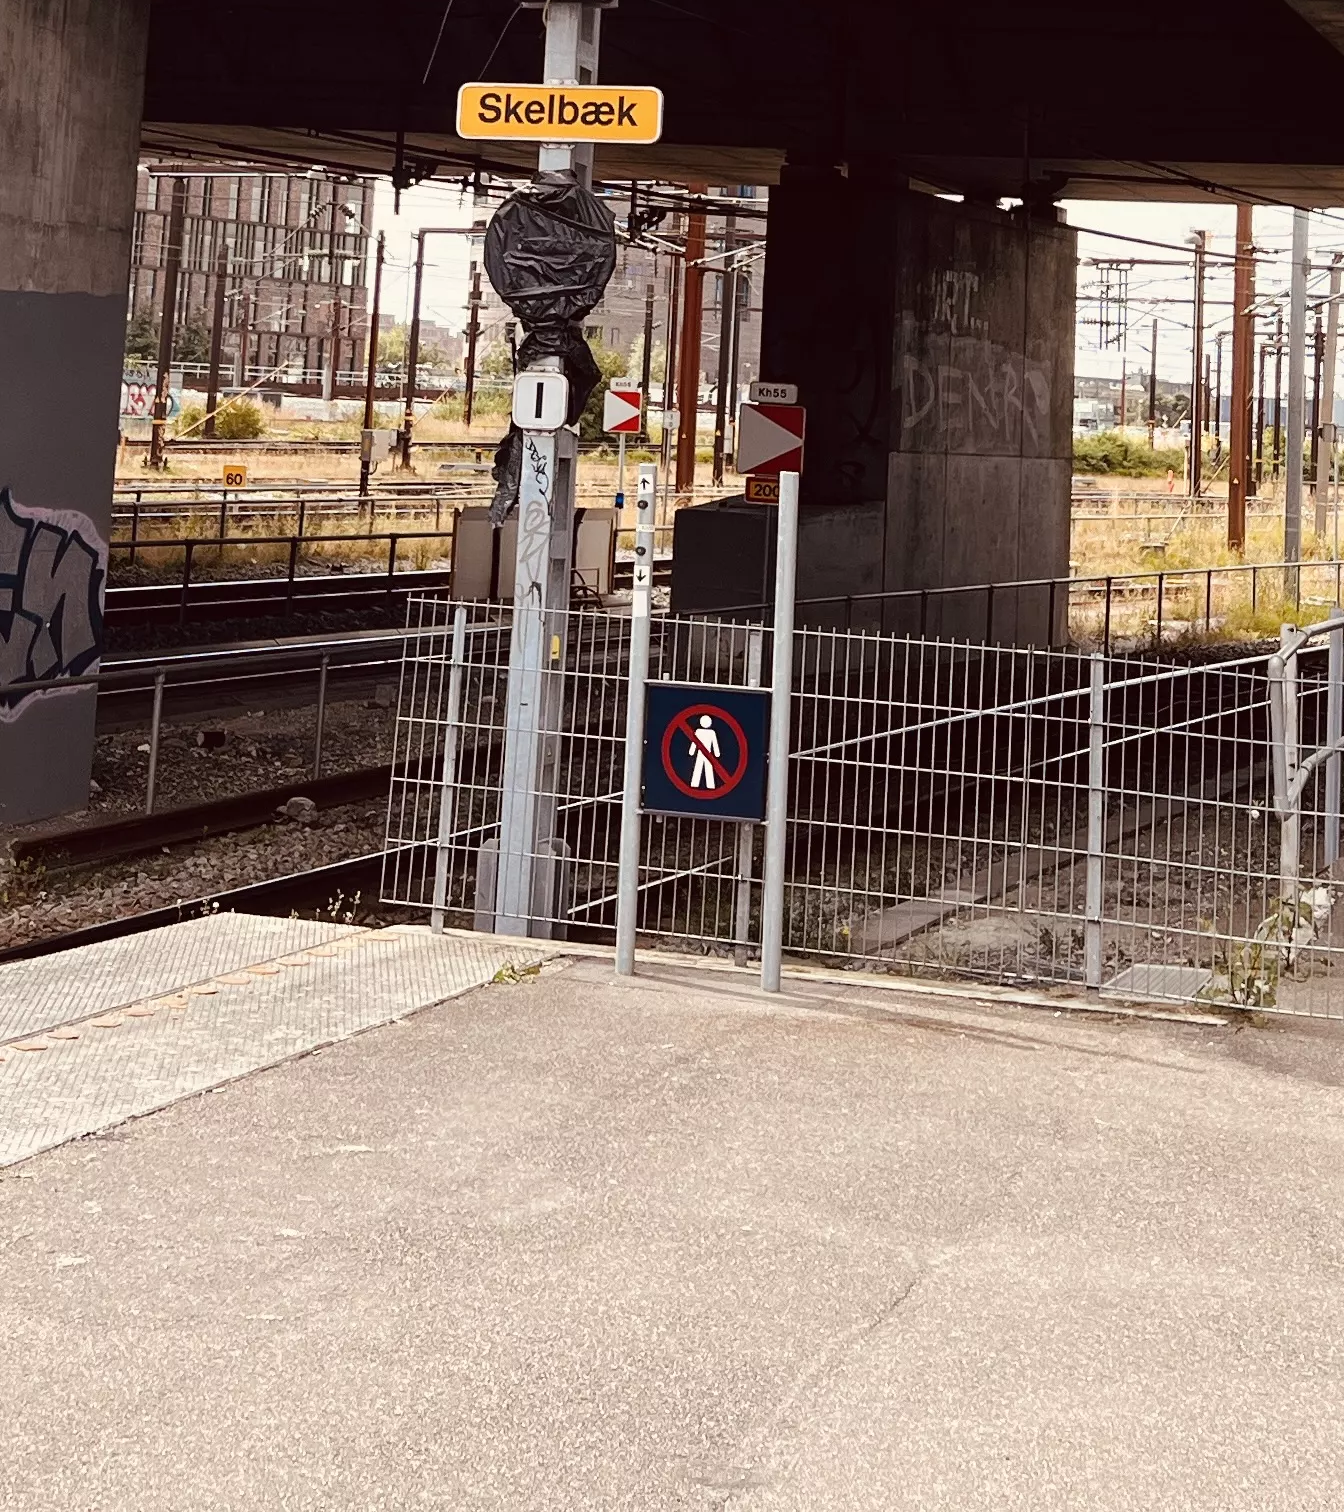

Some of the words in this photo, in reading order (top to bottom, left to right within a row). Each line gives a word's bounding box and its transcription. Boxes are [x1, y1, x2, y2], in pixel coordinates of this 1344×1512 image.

[478, 92, 638, 126] Skelbæk
[758, 387, 787, 399] Kh55
[226, 473, 243, 486] 60
